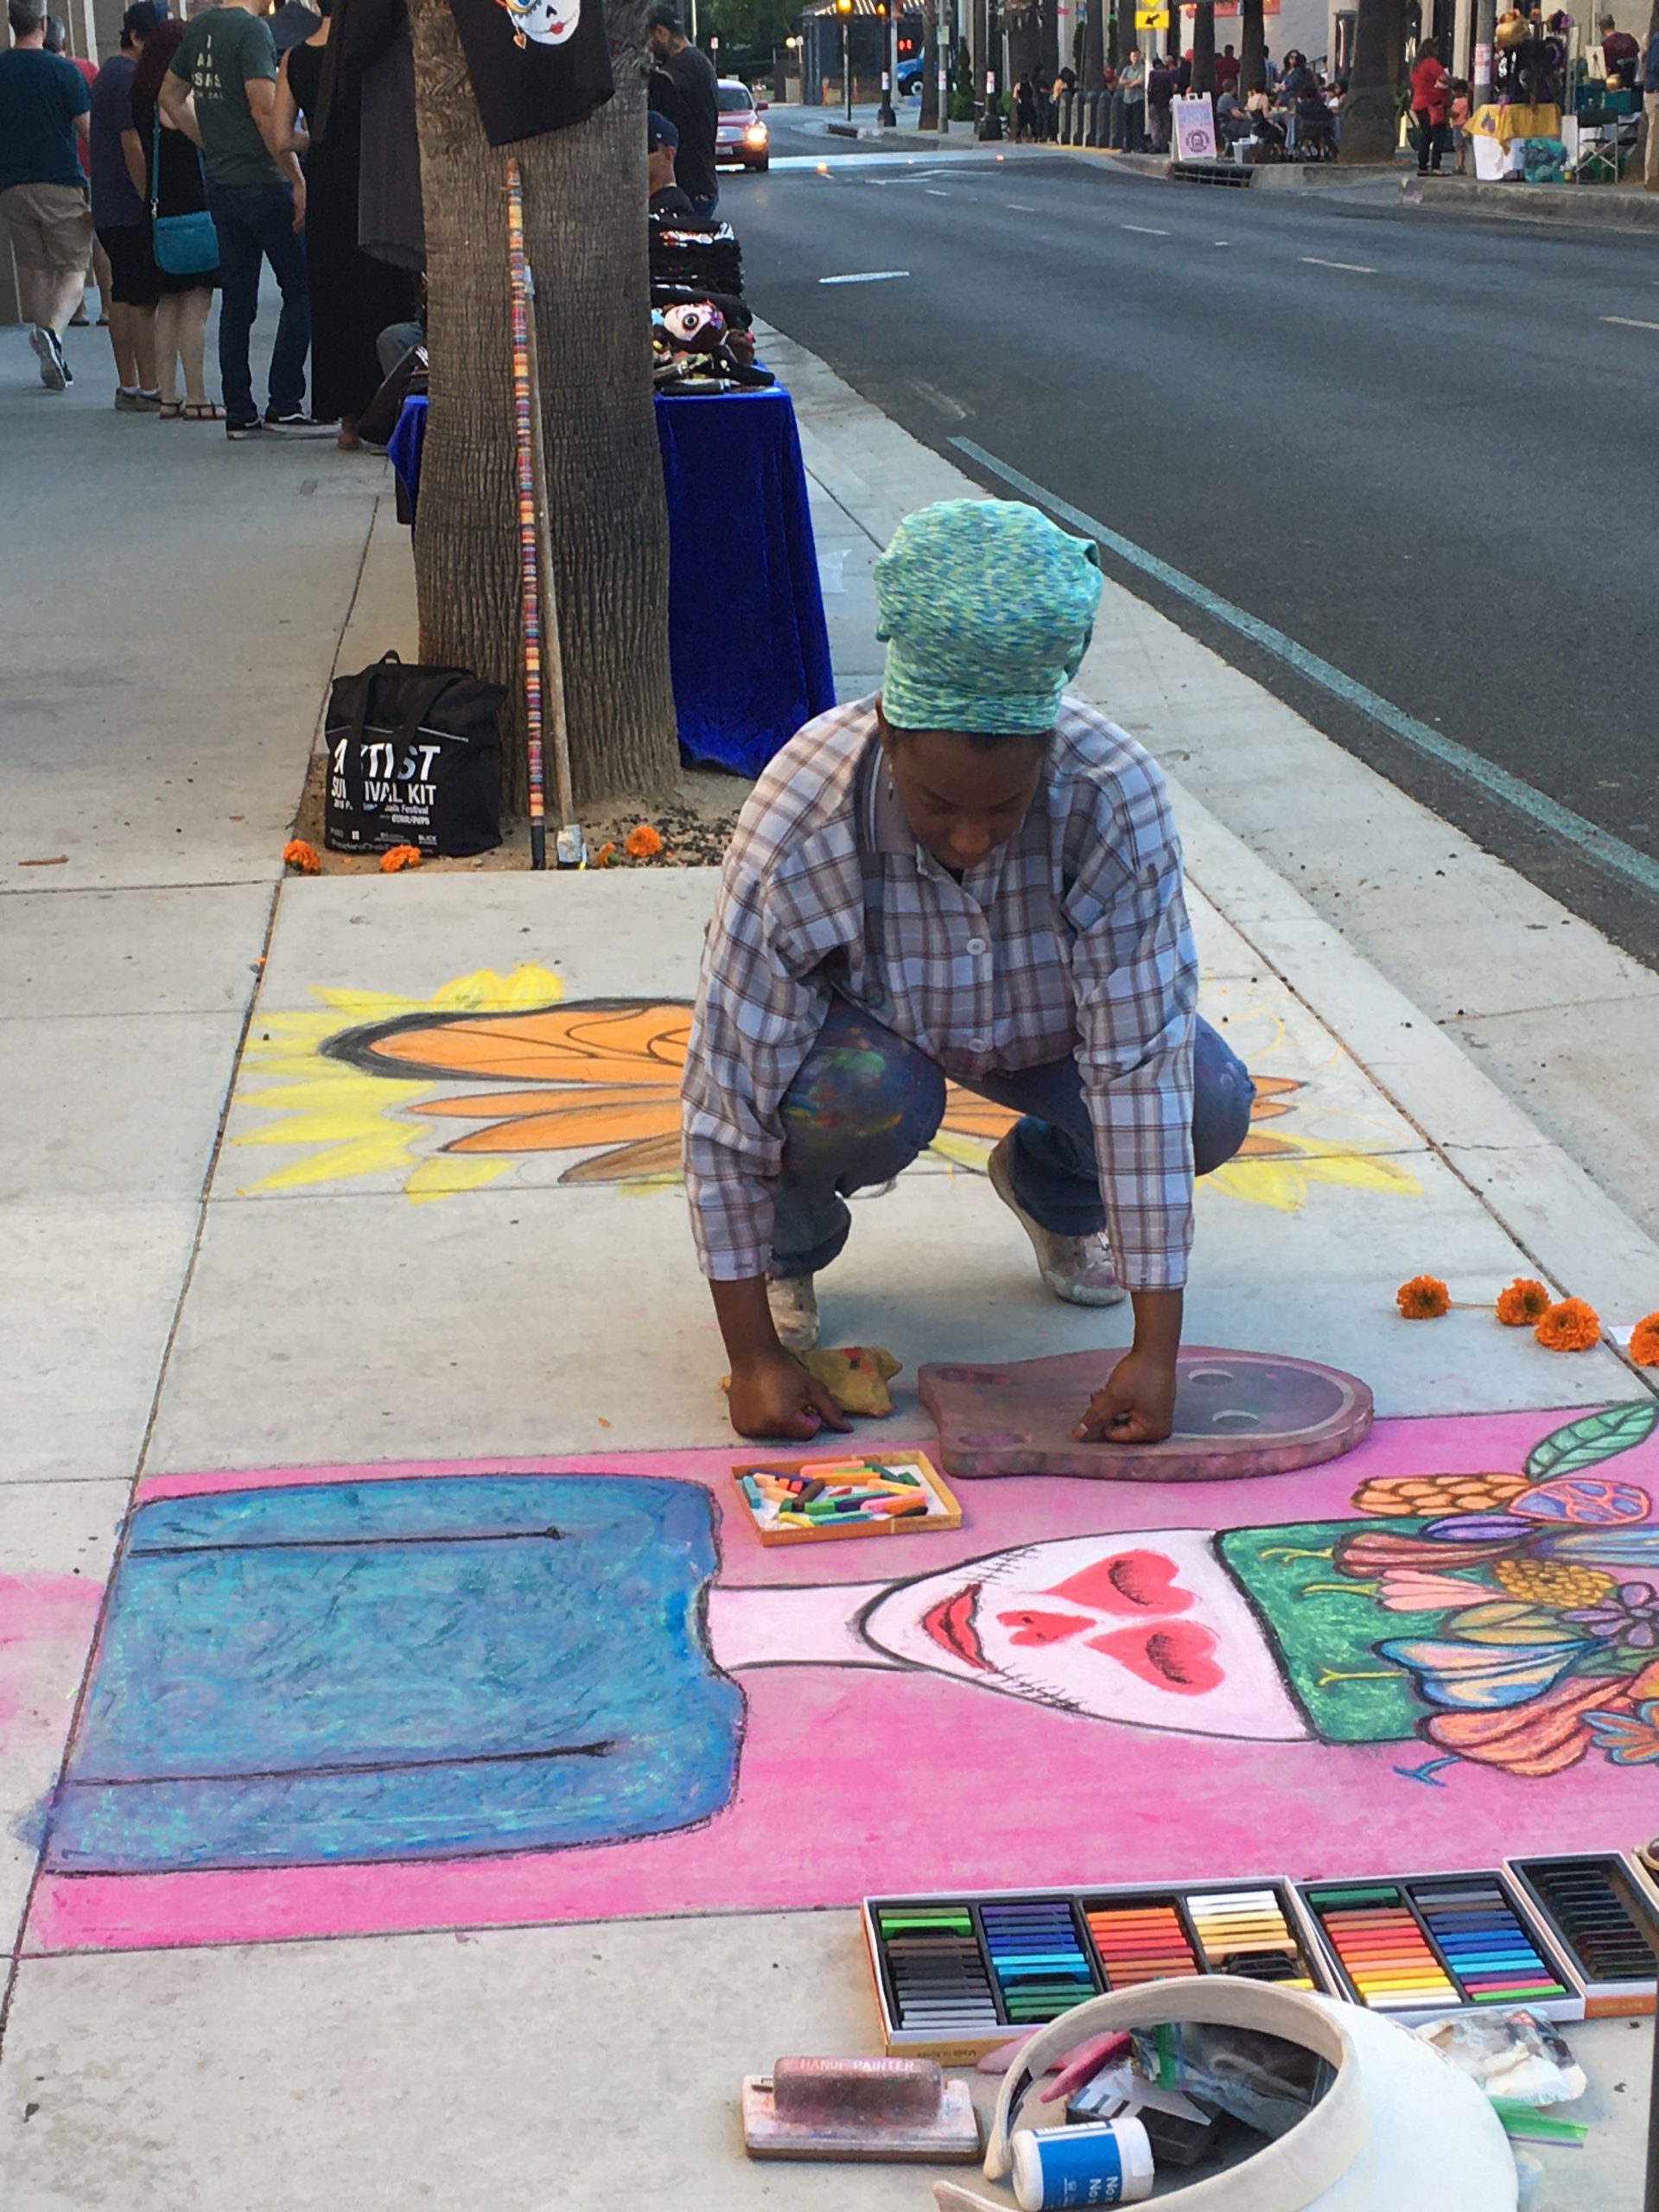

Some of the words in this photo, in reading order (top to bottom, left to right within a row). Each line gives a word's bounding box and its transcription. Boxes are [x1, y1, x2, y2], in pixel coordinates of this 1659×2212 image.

[334, 738, 441, 781] ATIST
[331, 776, 404, 804] SUIVAL
[408, 784, 437, 805] KIT
[401, 804, 429, 816] Festival
[853, 2060, 914, 2071] PAINTER
